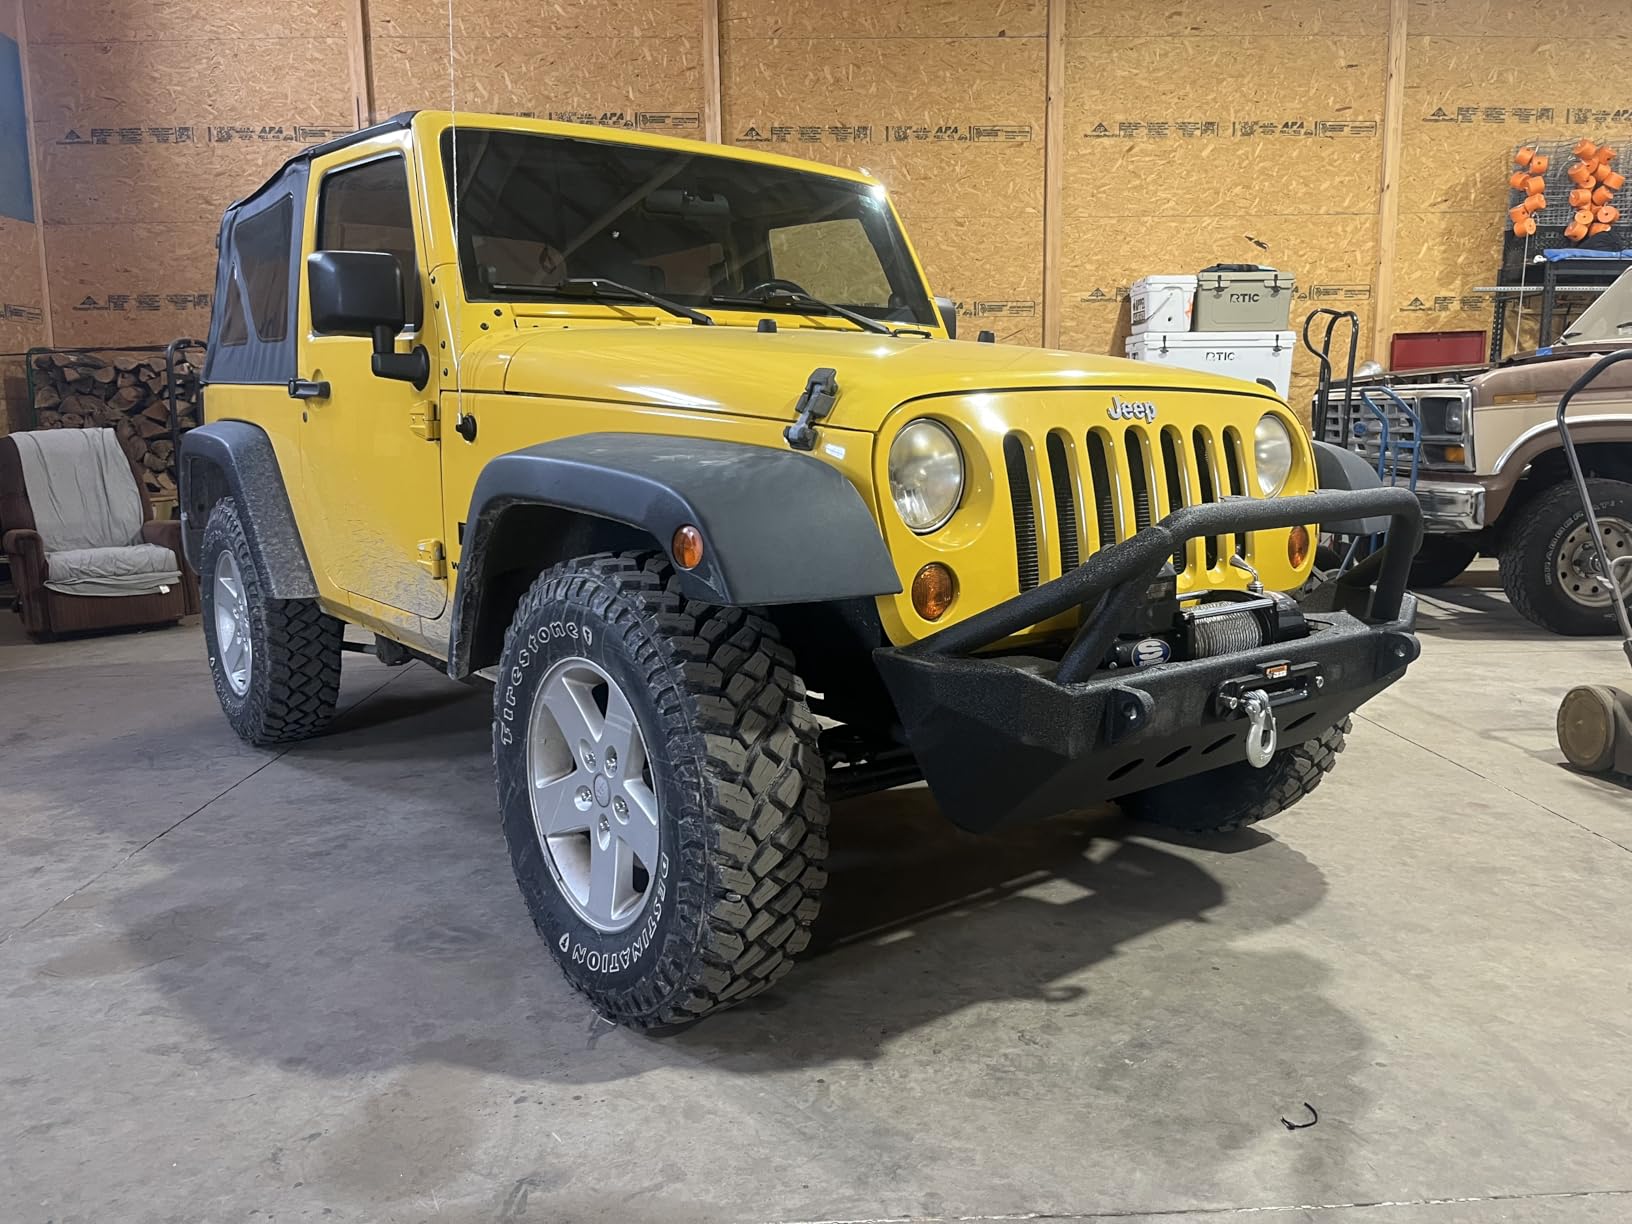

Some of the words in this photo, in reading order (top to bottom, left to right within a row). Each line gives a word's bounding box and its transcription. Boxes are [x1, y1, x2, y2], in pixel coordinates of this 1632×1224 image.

[1229, 293, 1260, 303] RTIC
[1205, 352, 1235, 361] RTIC
[1106, 396, 1157, 424] Jeep
[501, 621, 578, 745] Firestone
[572, 852, 669, 972] DESTINATION
